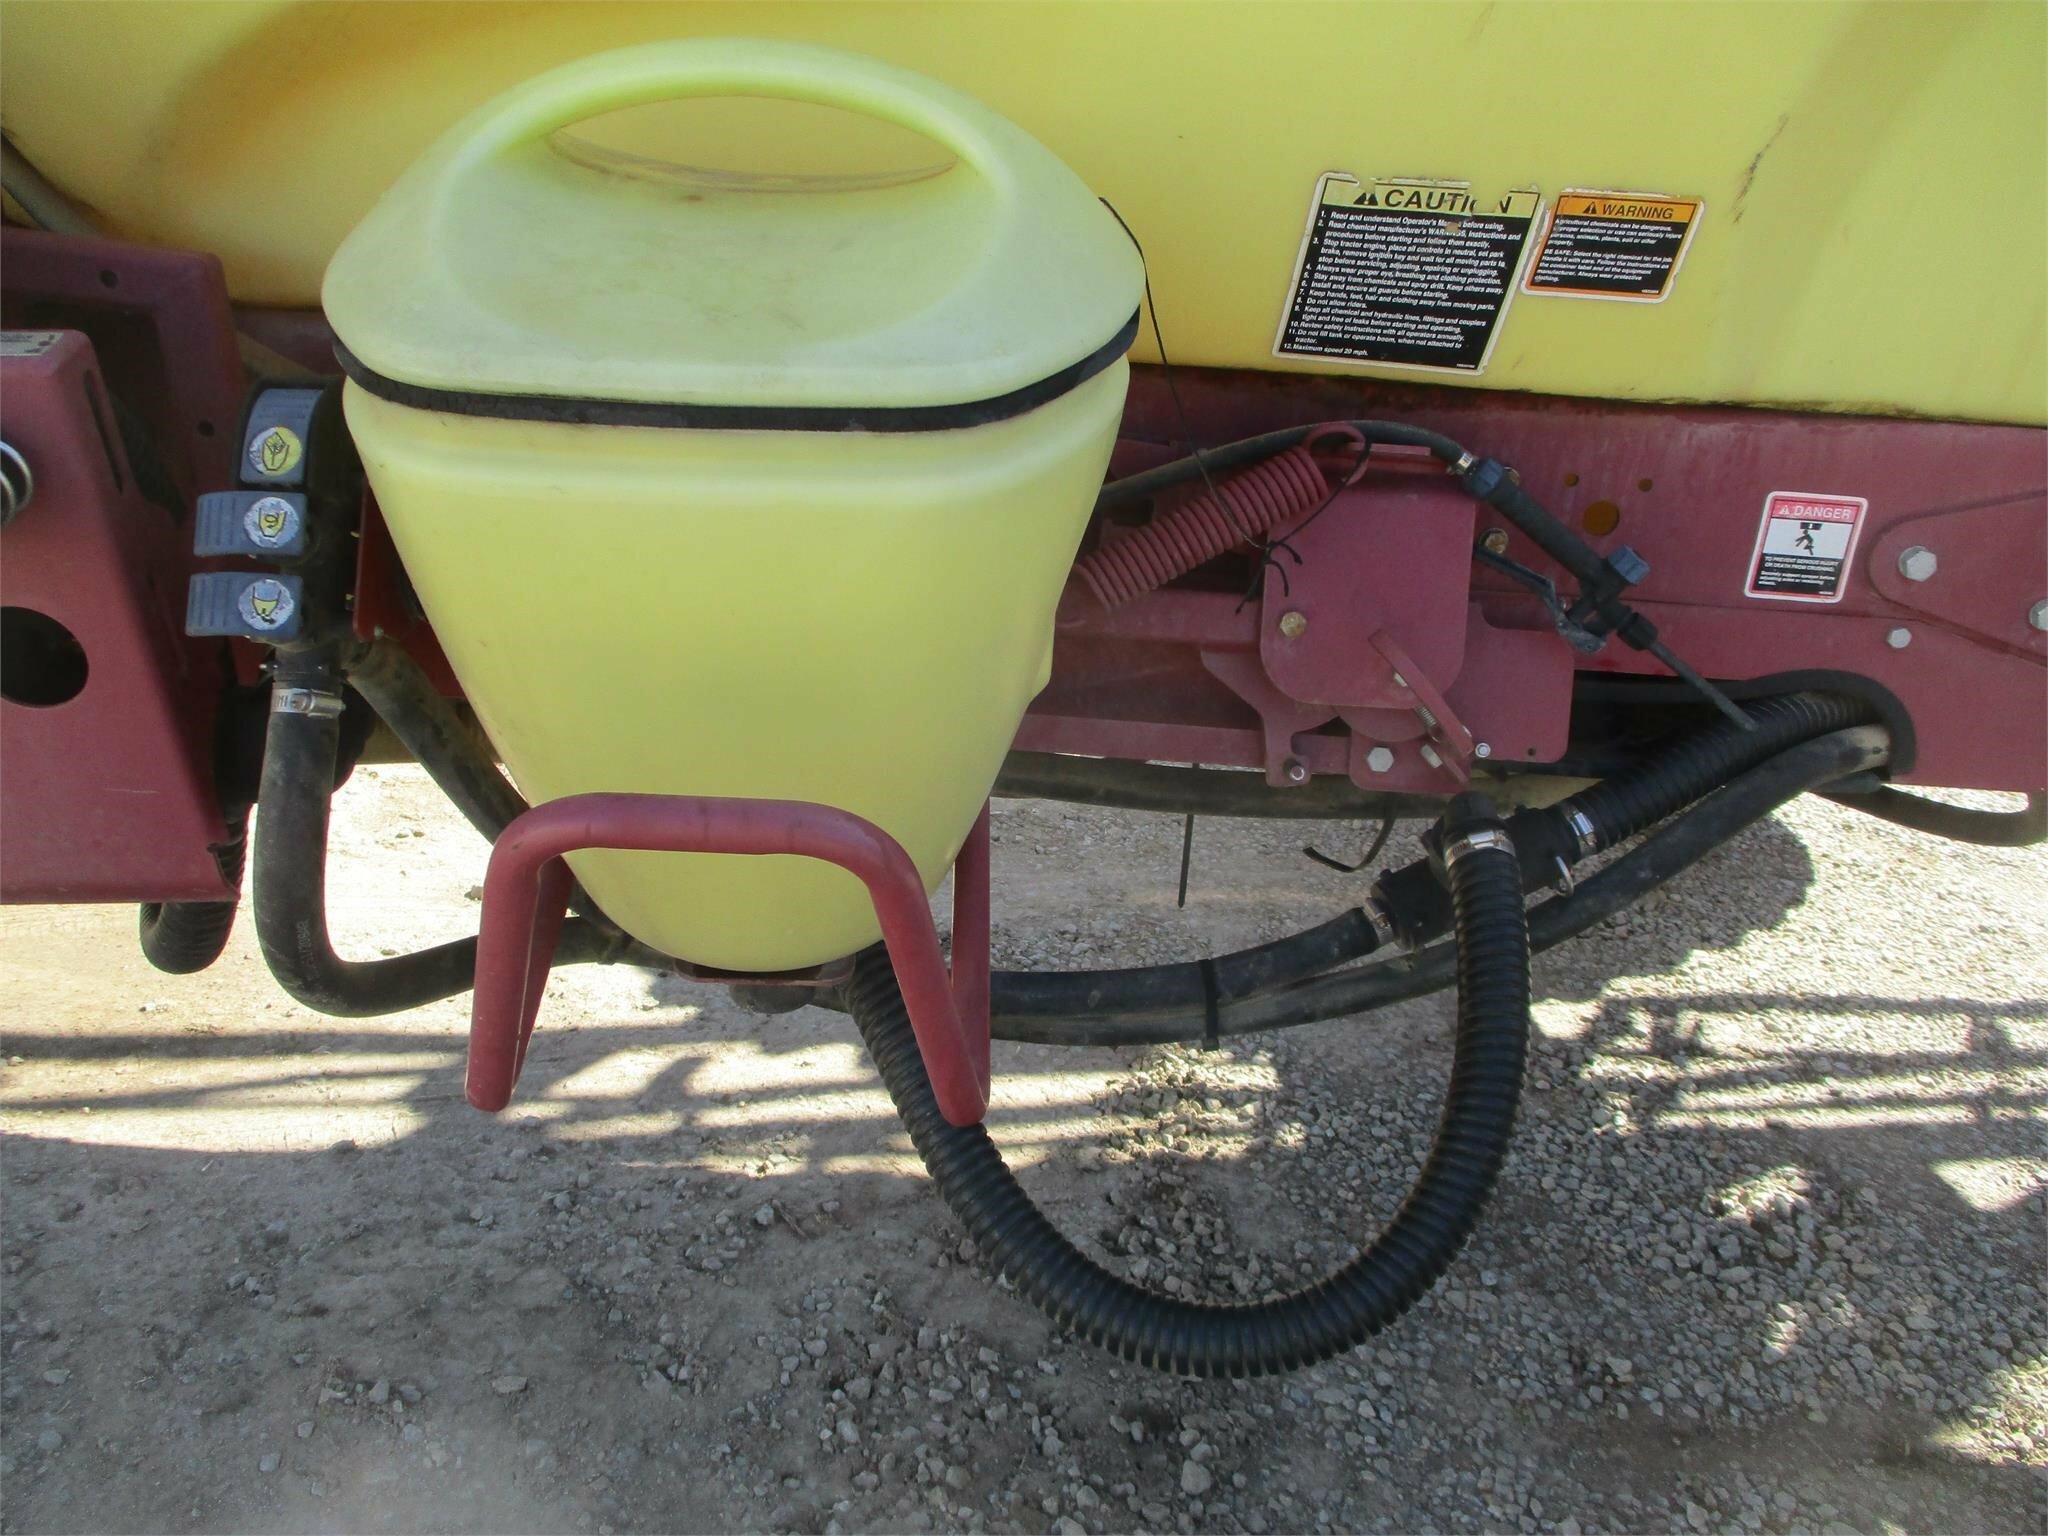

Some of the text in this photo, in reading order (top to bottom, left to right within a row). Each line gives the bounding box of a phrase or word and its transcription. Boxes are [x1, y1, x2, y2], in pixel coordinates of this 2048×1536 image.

[1602, 202, 1674, 220] WARNING
[1364, 215, 1401, 223] understand
[1403, 217, 1436, 225] Operator's
[1463, 221, 1484, 229] before
[1485, 223, 1505, 231] using.
[1326, 230, 1363, 239] procedures
[1428, 237, 1447, 245] follow
[1348, 222, 1377, 230] chemical
[1378, 225, 1427, 234] manufacturer's
[1469, 231, 1507, 240] instructions
[1341, 240, 1362, 248] tractor
[1364, 242, 1387, 250] engine,
[1417, 246, 1444, 254] controls
[1453, 248, 1477, 256] neutral,
[1357, 259, 1388, 267] servicing,
[1423, 264, 1452, 272] repairing
[1480, 259, 1497, 267] parts
[1317, 264, 1340, 272] Always
[1395, 270, 1426, 279] breathing
[1441, 274, 1467, 282] clothing
[1468, 276, 1502, 285] protection.
[1365, 277, 1397, 285] chemicals
[1447, 283, 1463, 291] Keep
[1310, 289, 1326, 297] Keep
[1327, 291, 1348, 299] hands,
[1392, 296, 1418, 304] clothing
[1453, 301, 1477, 309] moving
[1478, 303, 1496, 311] parts.
[1402, 288, 1423, 296] before
[1424, 290, 1450, 298] starting.
[1305, 305, 1321, 313] Keep
[1332, 308, 1360, 316] chemical
[1459, 318, 1486, 326] couplers
[1345, 325, 1382, 333] instructions
[1406, 330, 1436, 338] operators
[1437, 333, 1465, 341] annually.
[1393, 321, 1416, 329] starting
[1431, 324, 1462, 333] operating.
[1352, 333, 1376, 341] operate
[1377, 335, 1396, 343] boom,
[1428, 340, 1454, 348] attached
[1294, 343, 1323, 351] Maximum
[1353, 348, 1369, 356] mph.
[1794, 505, 1853, 520] DANGER
